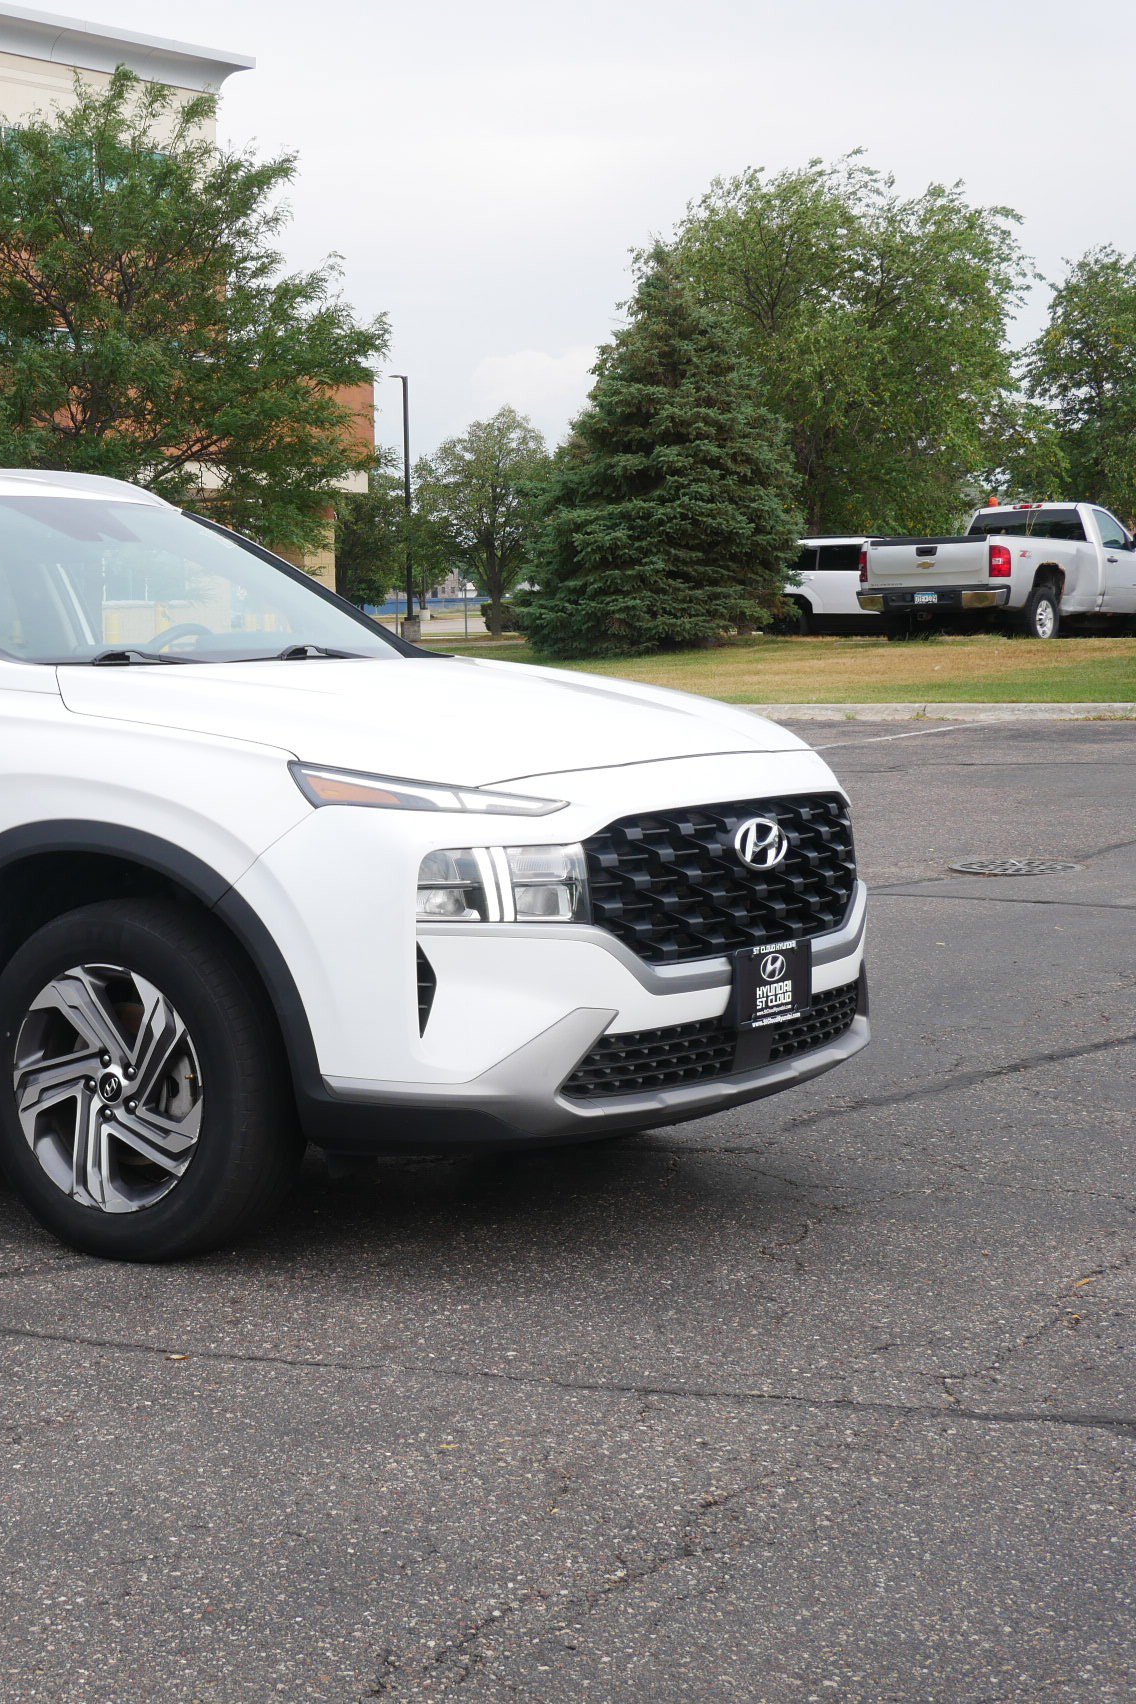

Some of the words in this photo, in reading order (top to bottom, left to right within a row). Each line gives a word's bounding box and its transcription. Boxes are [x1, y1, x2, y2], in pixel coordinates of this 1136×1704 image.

[760, 943, 775, 953] CLOUD
[776, 940, 796, 950] HYUNDAI
[756, 980, 792, 998] HYUNDAI
[756, 998, 767, 1009] ST
[768, 992, 792, 1006] CLOUD
